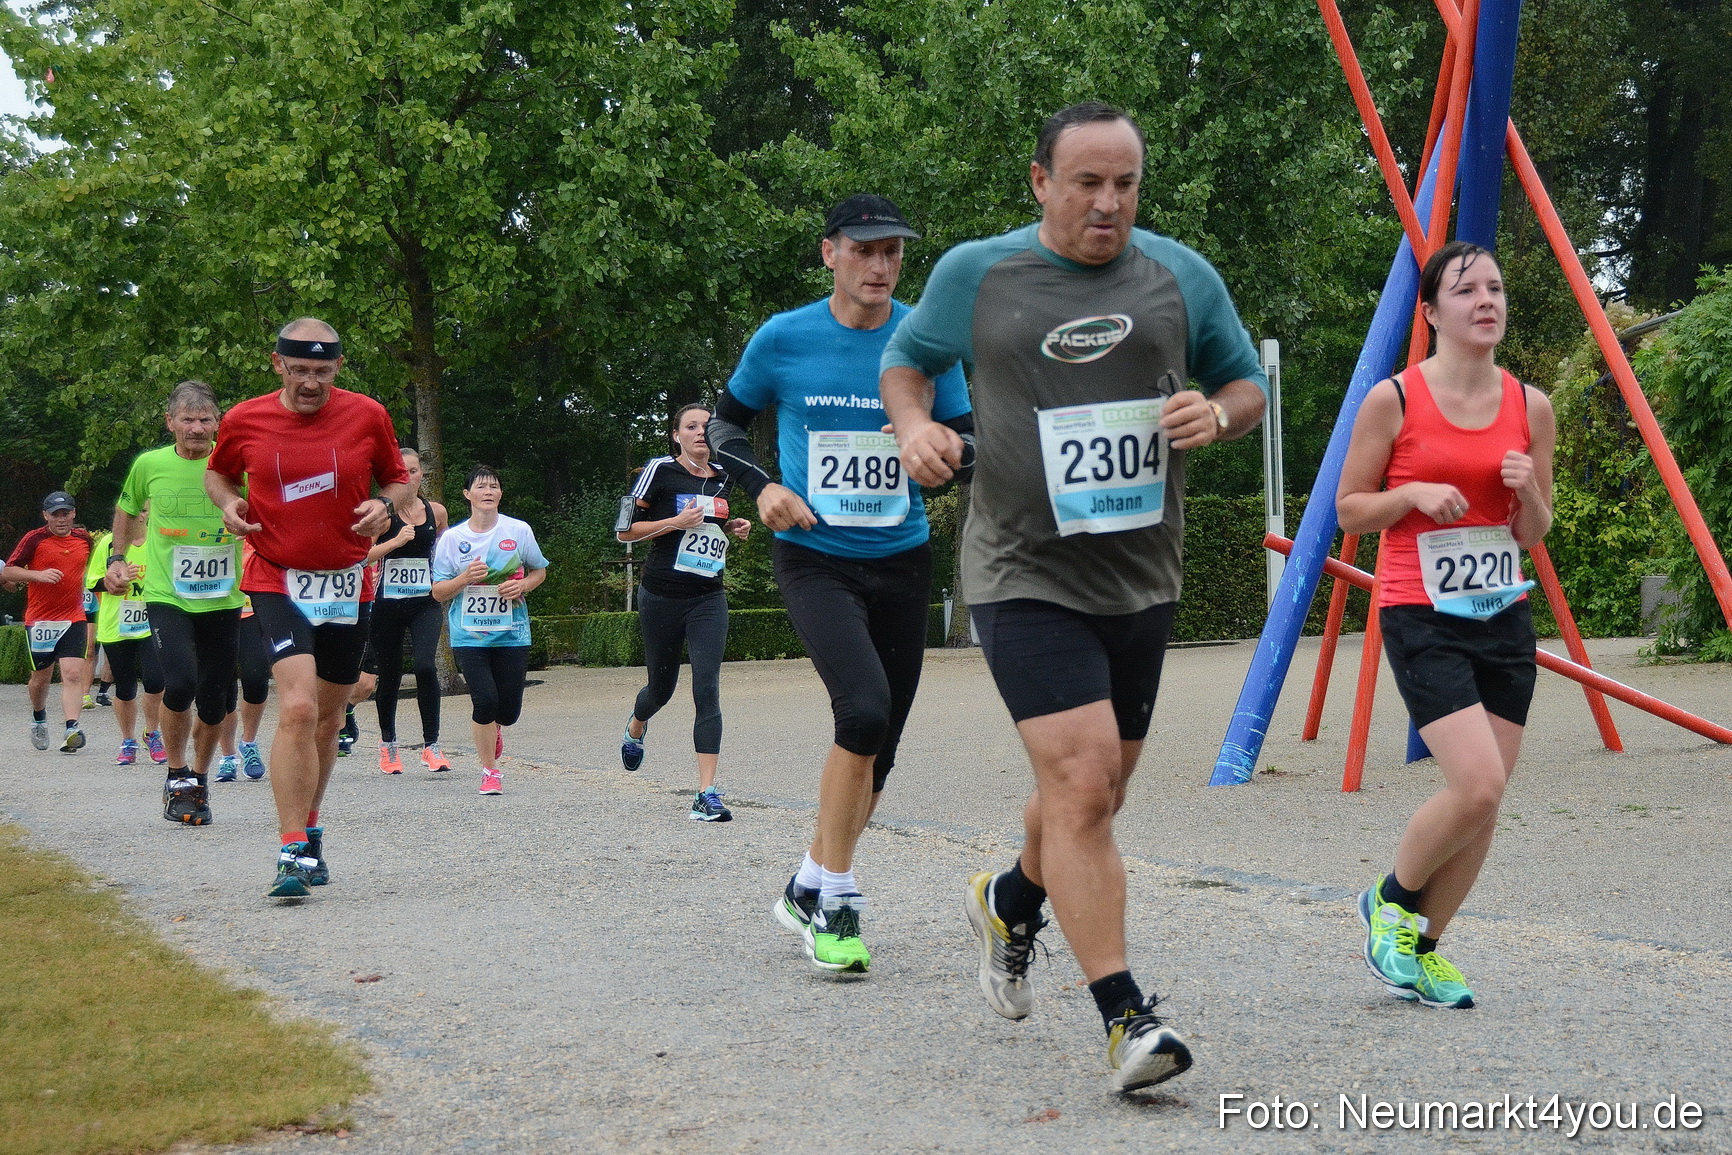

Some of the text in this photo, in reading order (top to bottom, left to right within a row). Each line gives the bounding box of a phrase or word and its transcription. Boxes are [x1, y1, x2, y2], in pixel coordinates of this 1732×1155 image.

[1060, 432, 1160, 485] 2304
[821, 455, 901, 490] 2489
[298, 481, 321, 494] DEHN
[840, 499, 882, 513] Hubert
[1090, 495, 1143, 513] Johann
[685, 533, 726, 560] 2399
[180, 556, 228, 579] 2401
[389, 568, 426, 584] 2807
[1435, 551, 1513, 593] 2220
[189, 582, 221, 592] Michael
[297, 572, 356, 600] 2793
[313, 605, 346, 616] Helmut
[467, 596, 508, 614] 2378
[1471, 597, 1504, 614] Julia
[473, 617, 501, 626] Krystyna
